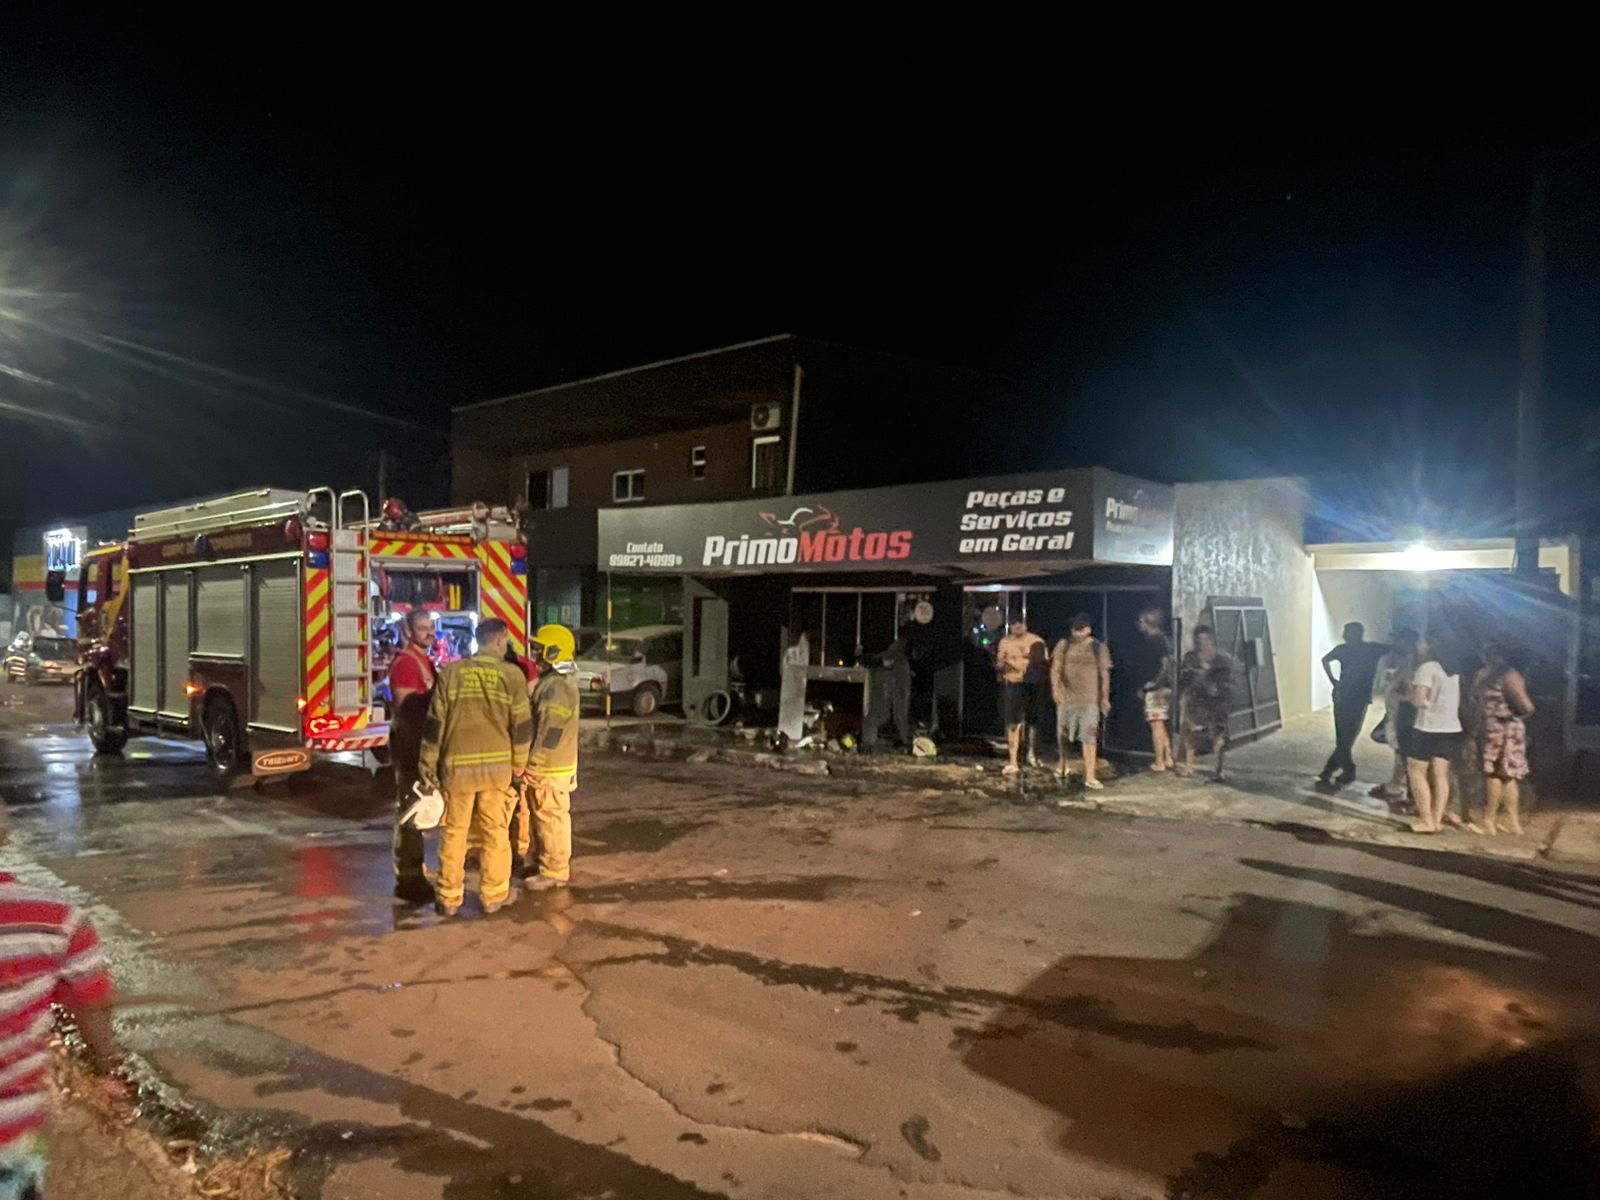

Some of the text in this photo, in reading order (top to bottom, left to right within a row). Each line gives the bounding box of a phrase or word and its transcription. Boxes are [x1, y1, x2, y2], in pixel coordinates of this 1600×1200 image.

[966, 487, 1066, 509] Peças e
[960, 510, 1073, 531] Serviços
[626, 542, 664, 553] Contato
[959, 531, 1075, 553] em Geral
